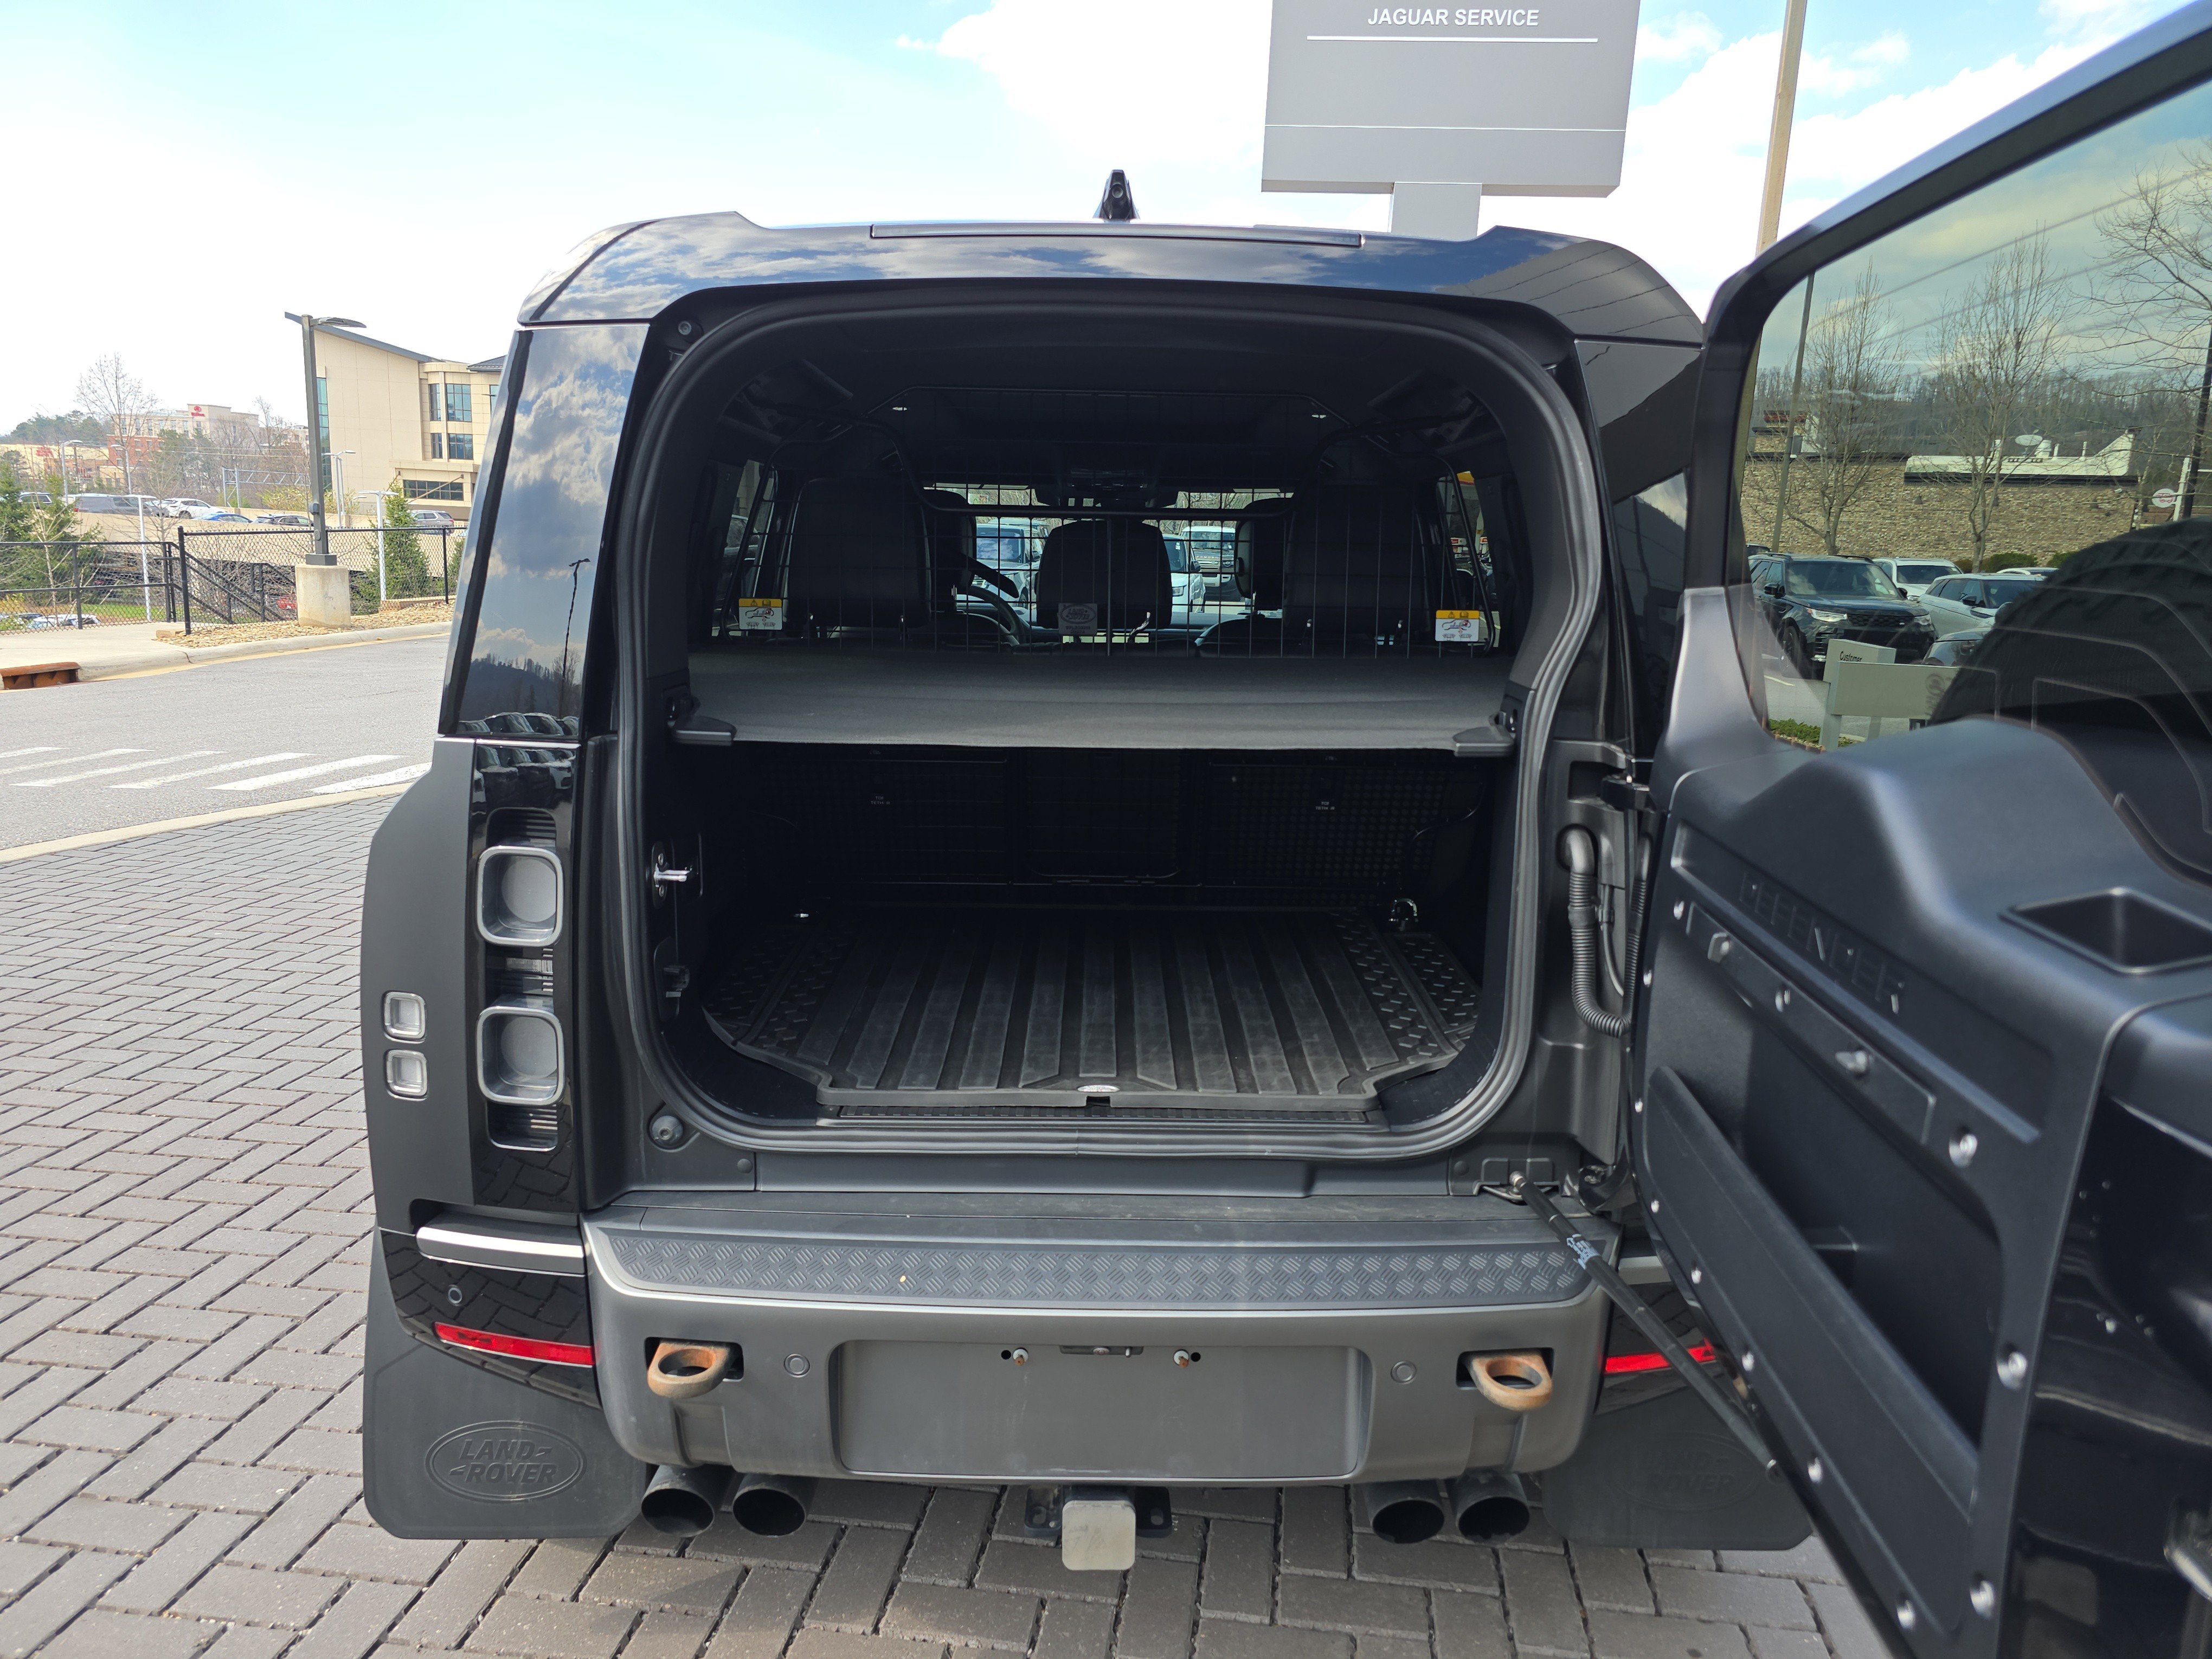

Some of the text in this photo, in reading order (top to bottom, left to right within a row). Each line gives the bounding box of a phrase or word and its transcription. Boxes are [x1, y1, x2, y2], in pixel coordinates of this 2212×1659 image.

[1367, 8, 1539, 26] JAGUAR SERVICE
[1840, 651, 1862, 662] Customer
[1739, 871, 1906, 1016] DEFENDER
[459, 1438, 536, 1461] LAND
[464, 1462, 558, 1484] ROVER
